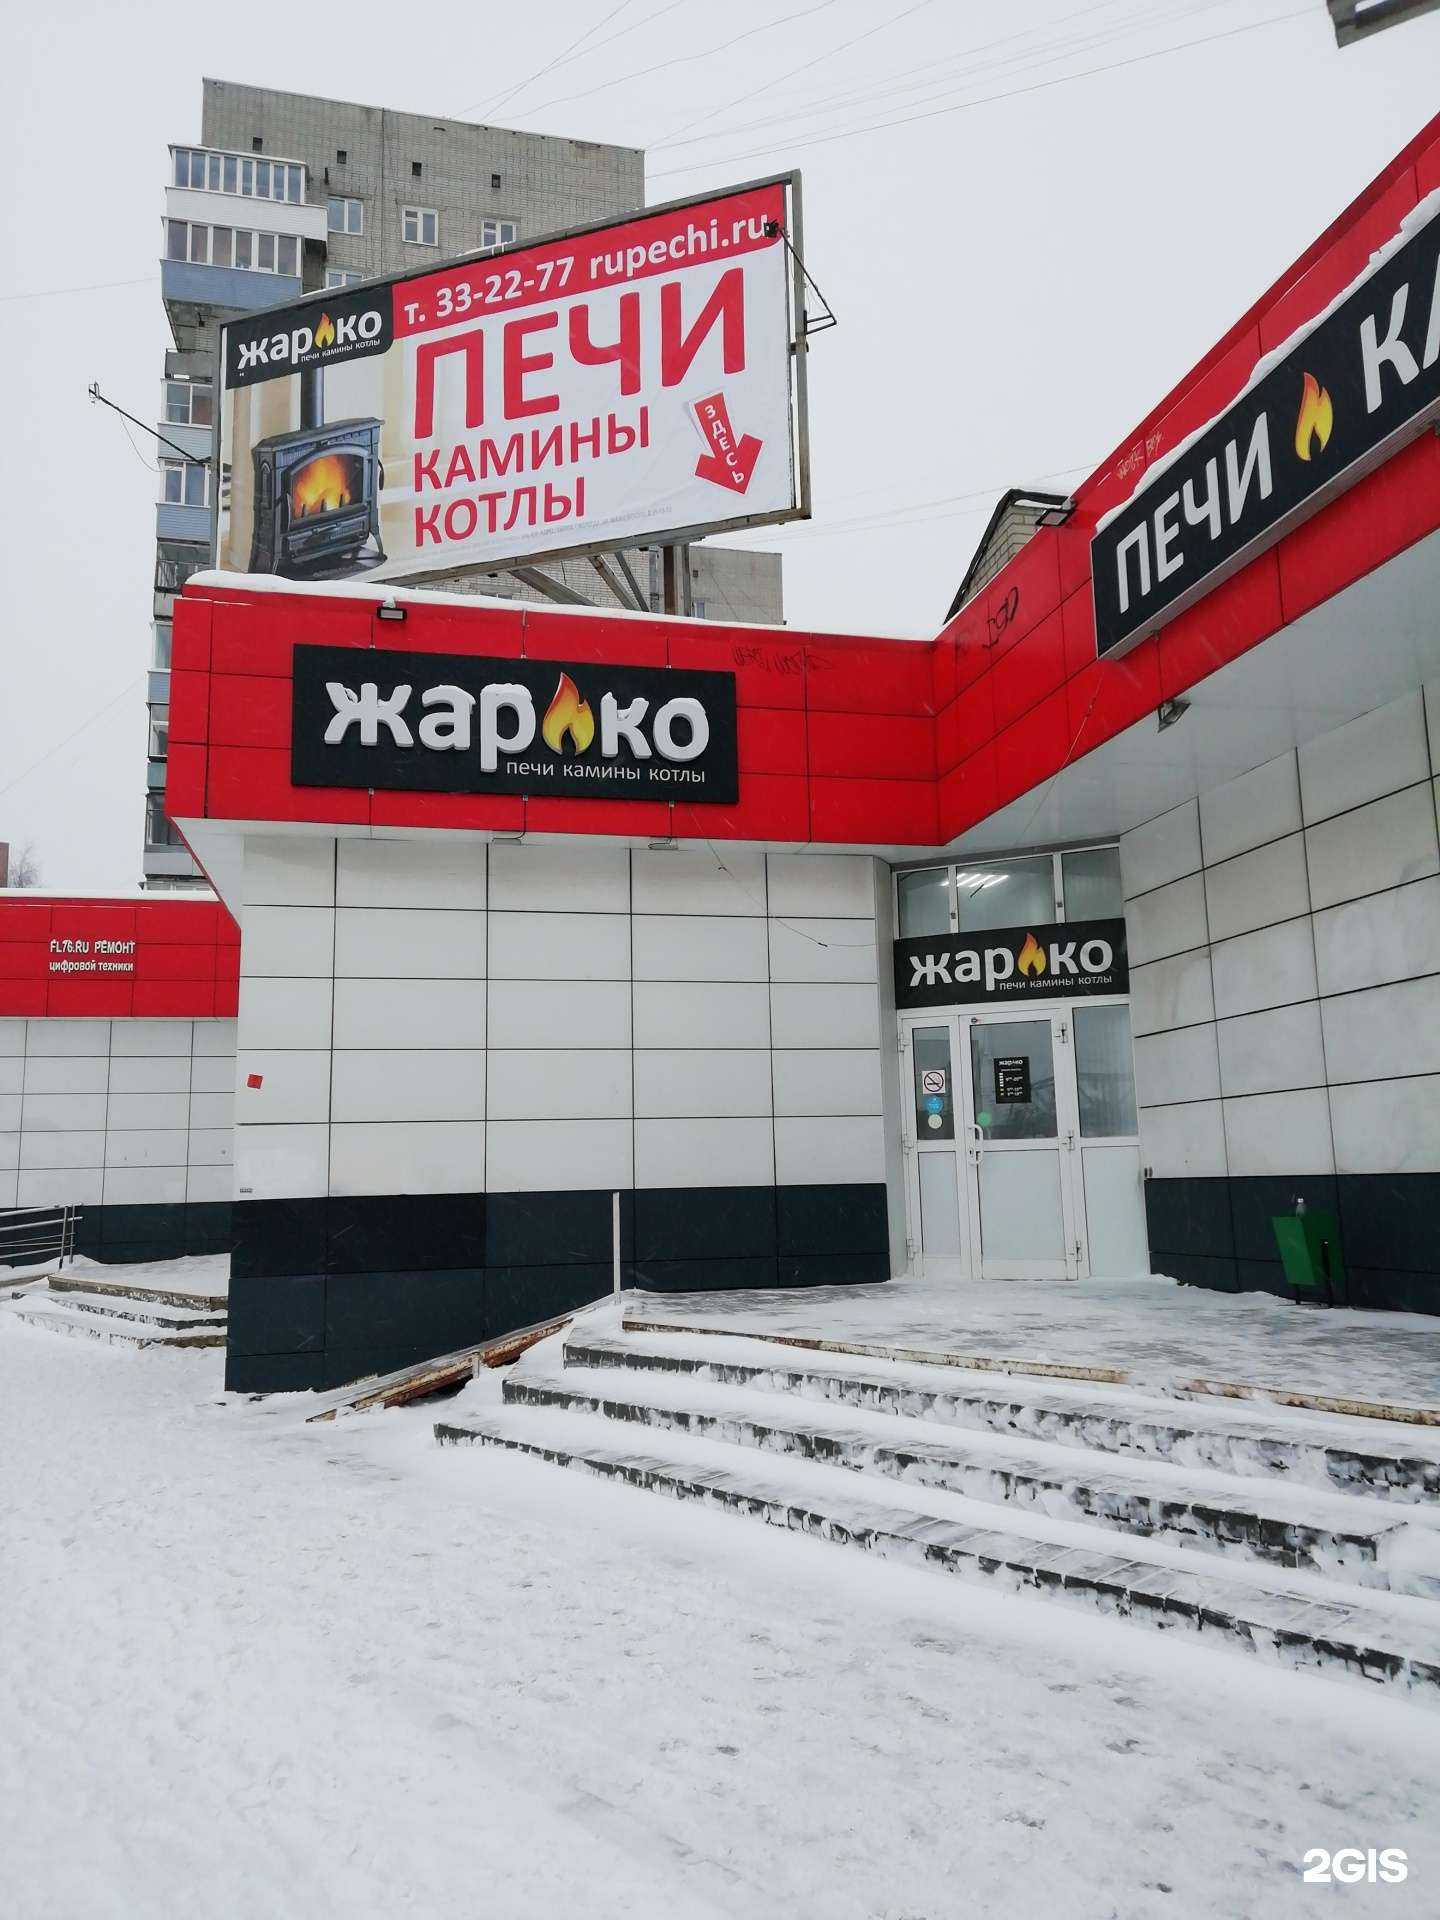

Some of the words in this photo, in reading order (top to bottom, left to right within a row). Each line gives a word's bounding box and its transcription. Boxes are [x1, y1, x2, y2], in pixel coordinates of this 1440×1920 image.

[404, 303, 426, 325] т.
[436, 256, 575, 318] 33-22-77
[590, 213, 770, 280] rupechi.ru
[322, 344, 353, 358] камины
[355, 338, 381, 350] котлы
[413, 267, 746, 440] ПЕЧИ
[413, 404, 650, 492] КАМИНЫ
[704, 404, 745, 484] ЗДЕСЬ
[413, 476, 586, 548] КОТЛЫ
[1115, 411, 1273, 614] ПЕЧИ
[506, 759, 554, 778] печи
[563, 764, 641, 781] камины
[649, 767, 706, 783] котлы
[49, 959, 96, 973] цифровой
[98, 961, 134, 972] техники
[50, 939, 90, 954] FL76.RU
[94, 939, 136, 955] РЕМОНТ
[1000, 980, 1026, 991] печи
[1030, 977, 1074, 989] камины
[1078, 974, 1113, 986] котлы
